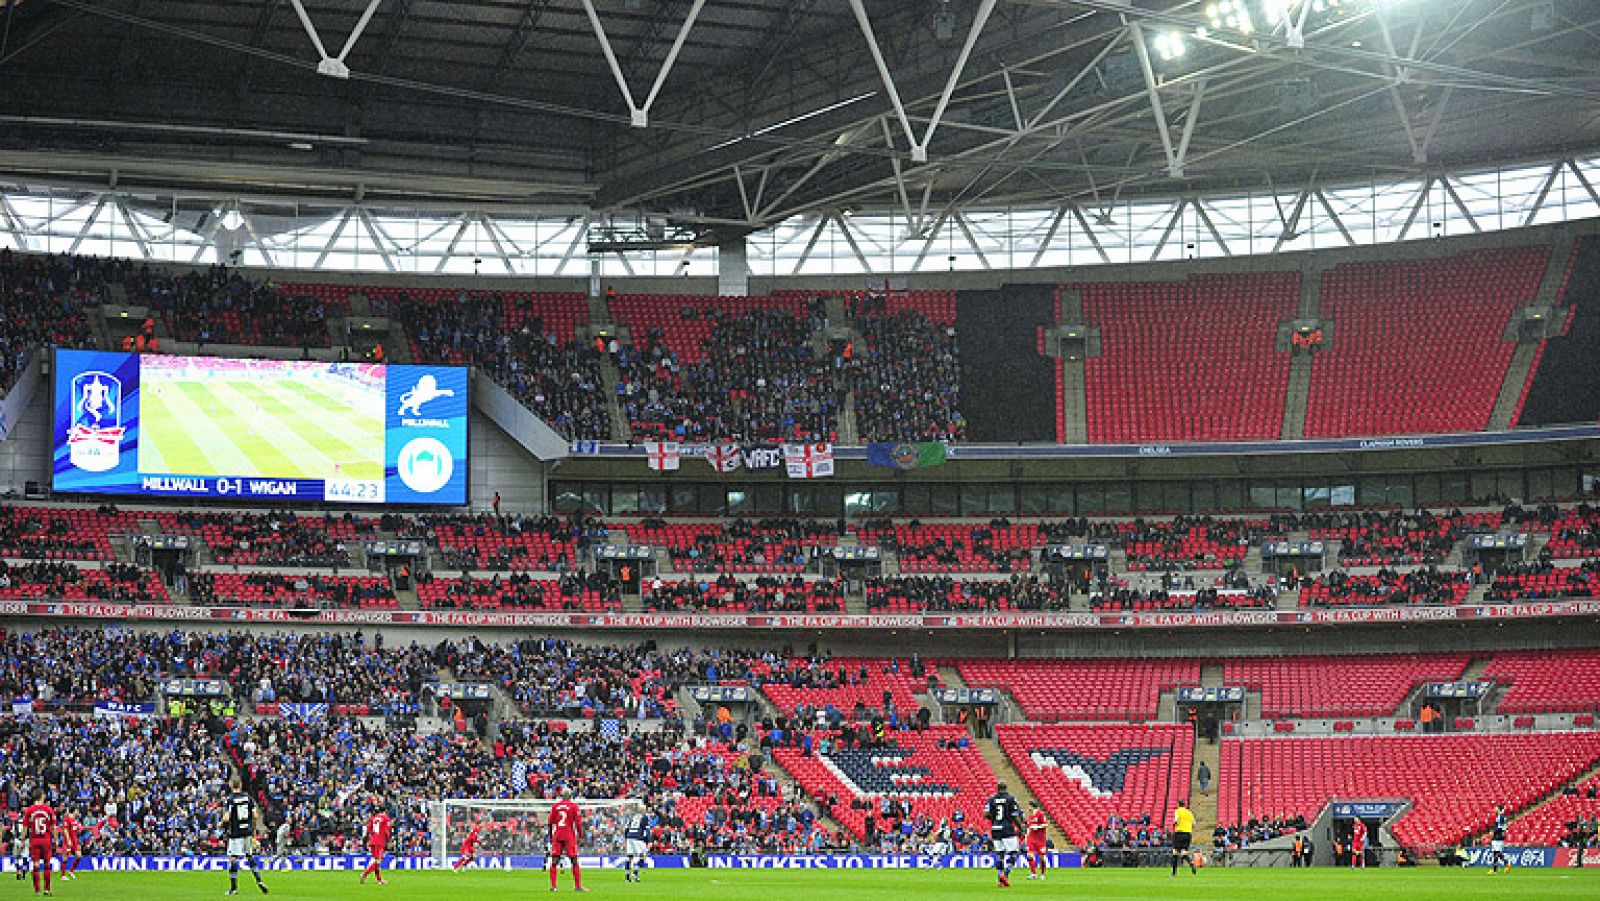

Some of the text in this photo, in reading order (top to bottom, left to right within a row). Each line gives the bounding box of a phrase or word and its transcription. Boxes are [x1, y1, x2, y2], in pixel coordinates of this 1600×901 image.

[144, 477, 297, 495] MILLWALL 0-1 WIGAN
[329, 484, 378, 498] 44:23
[558, 811, 567, 827] 2
[91, 857, 148, 870] WIN
[154, 857, 251, 870] TICKES
[447, 857, 512, 869] FNAL
[738, 857, 827, 868] TICKETS
[832, 857, 864, 868] TO
[869, 856, 910, 868] THE
[950, 855, 995, 868] CUP
